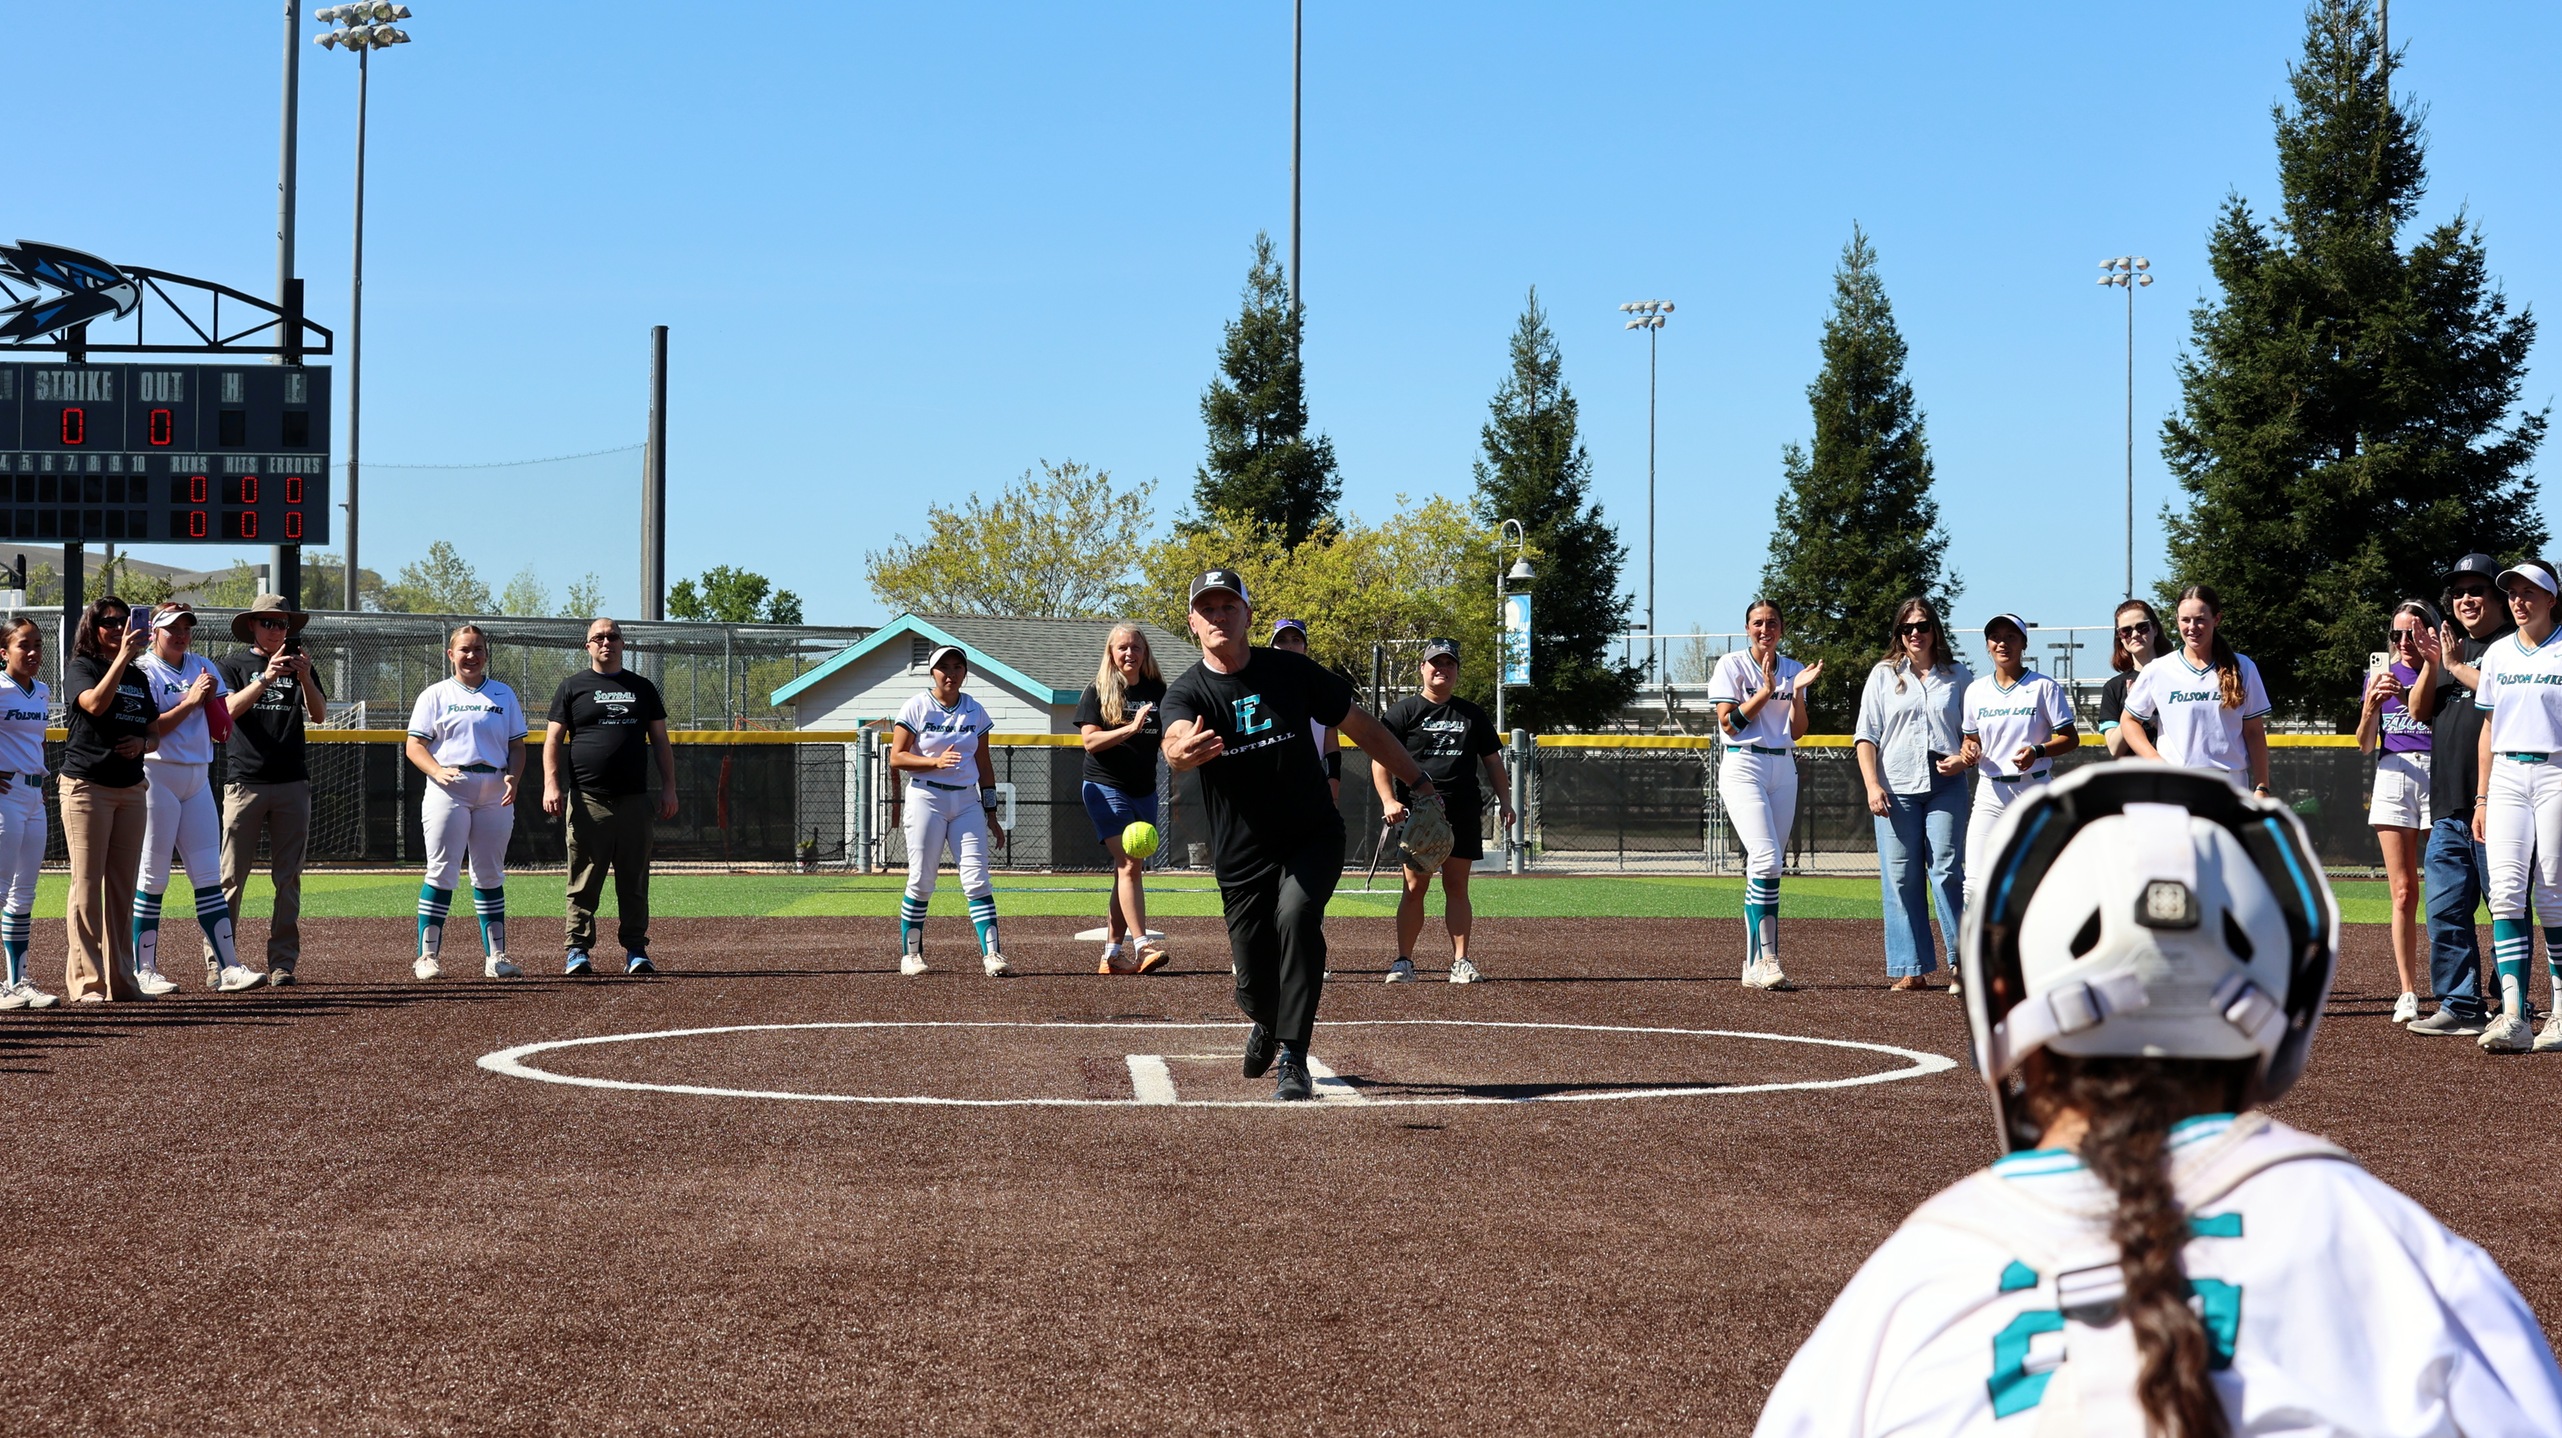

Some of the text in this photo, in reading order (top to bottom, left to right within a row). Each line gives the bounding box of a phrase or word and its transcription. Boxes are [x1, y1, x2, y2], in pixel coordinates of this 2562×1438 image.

[36, 370, 112, 401] STRIKE
[140, 371, 183, 402] OUT
[226, 372, 239, 403] H
[62, 407, 84, 445] 0
[150, 409, 171, 446] 0
[22, 454, 30, 472] 5
[45, 455, 52, 472] 6
[67, 455, 75, 472] 7
[90, 455, 97, 473] 8
[112, 455, 120, 473] 9
[132, 455, 146, 473] 10
[172, 456, 207, 473] RUNS
[226, 457, 256, 473] HITS
[269, 457, 320, 474] ERRORS
[190, 476, 207, 503] 0
[241, 476, 258, 504] 0
[286, 477, 302, 504] 0
[189, 510, 207, 537] 0
[241, 511, 257, 538] 0
[286, 511, 302, 538] 0
[2497, 672, 2533, 686] FOLSOM
[447, 703, 504, 715] FOLSOM LAKE
[2168, 690, 2210, 705] FOLSOM
[4, 708, 41, 721] FOLSOM
[1976, 706, 2037, 720] FOLSOM LAKE
[1220, 731, 1296, 758] SOFTBALL
